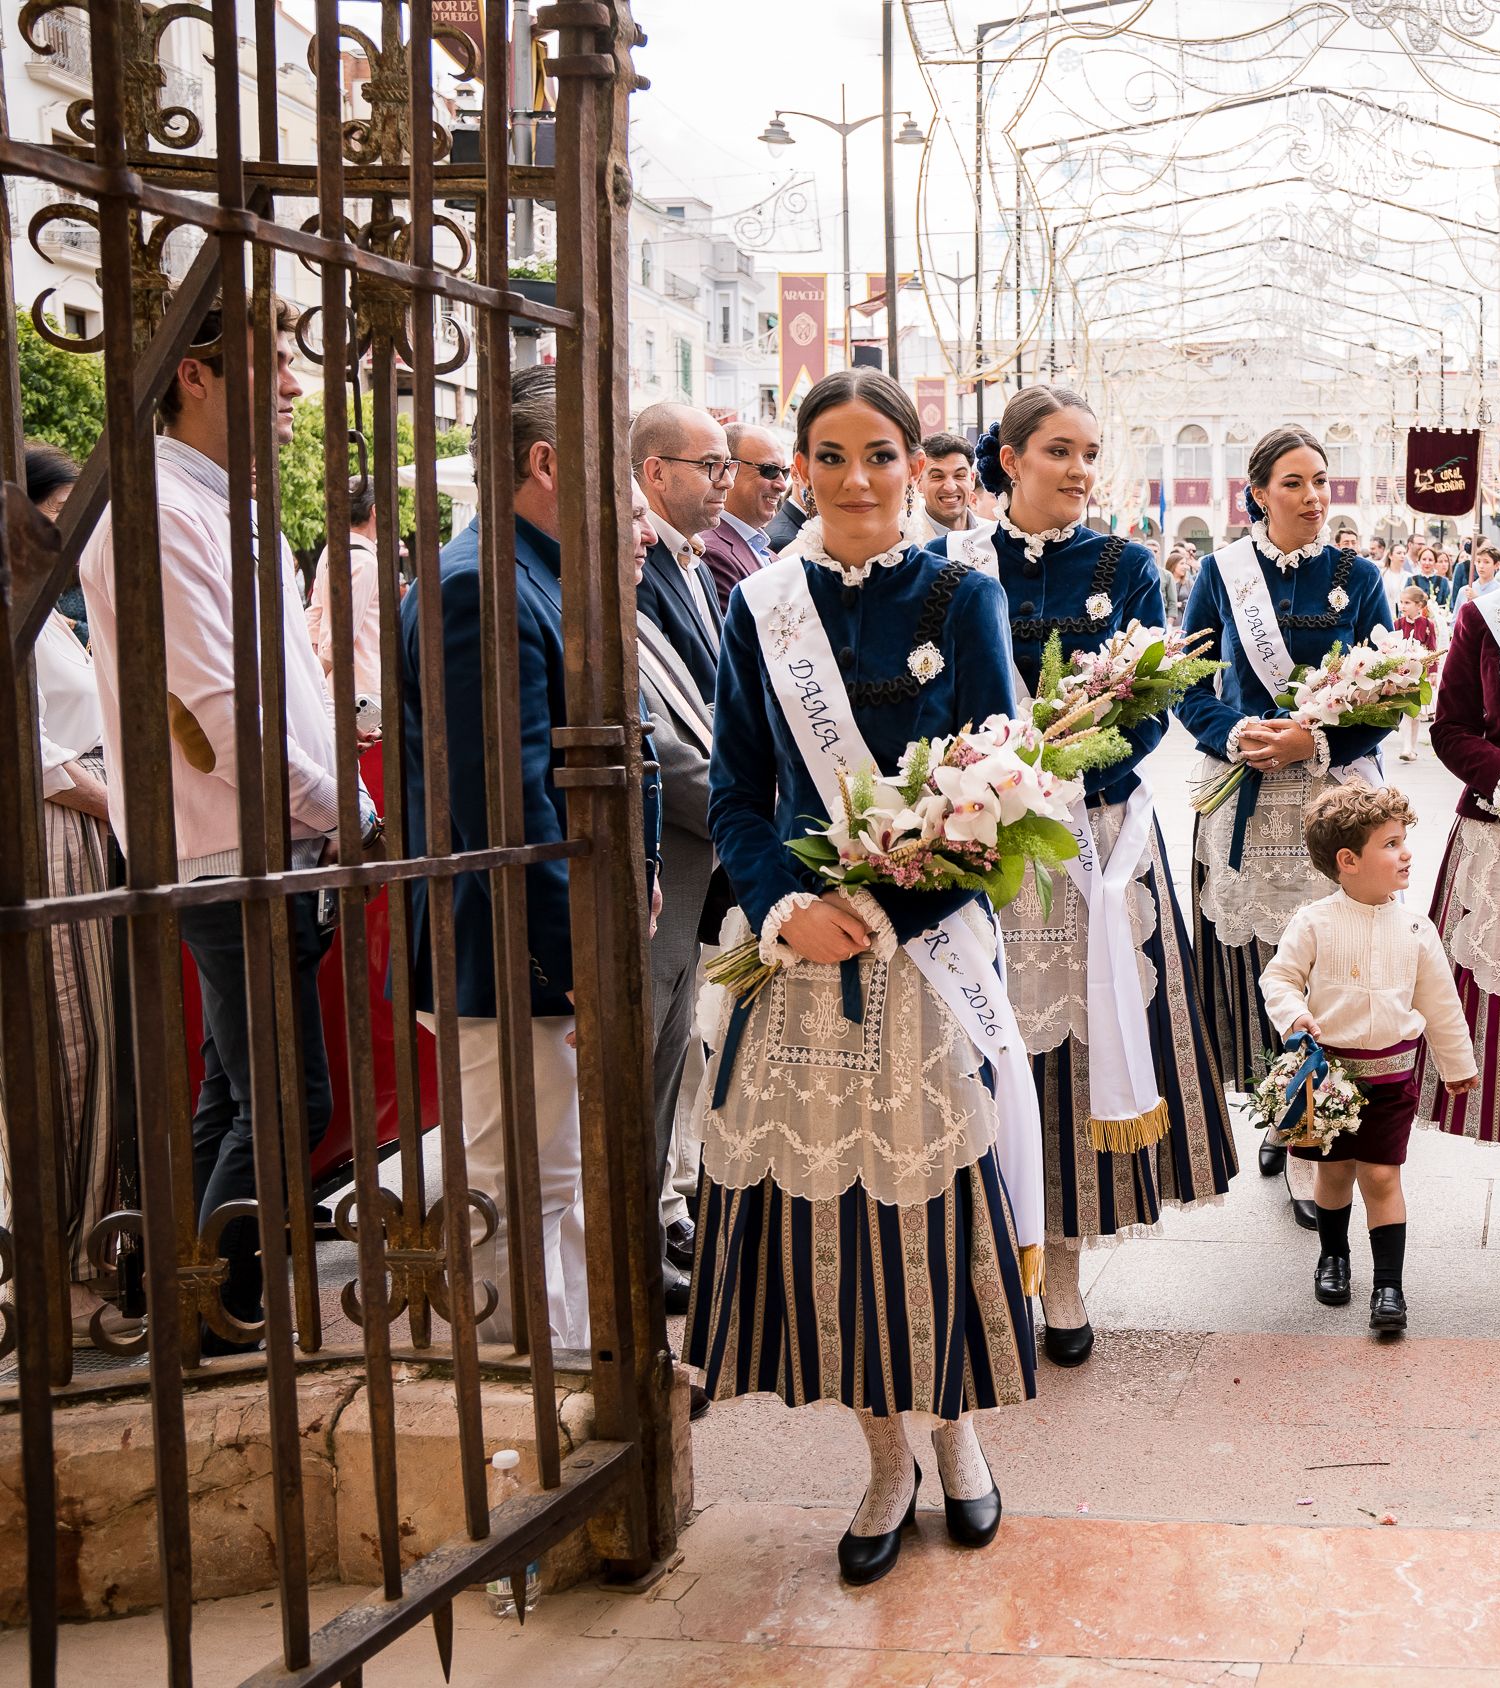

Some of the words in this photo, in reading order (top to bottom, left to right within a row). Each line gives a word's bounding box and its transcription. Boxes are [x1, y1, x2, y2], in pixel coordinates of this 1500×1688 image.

[432, 1, 457, 11] NOR
[461, 1, 478, 12] DE
[440, 13, 479, 21] PUEBLO
[783, 290, 825, 301] ARACELI
[1244, 605, 1275, 662] DAMA
[788, 659, 840, 753] DAMA
[1071, 828, 1093, 872] 2026
[960, 982, 1003, 1037] 2026
